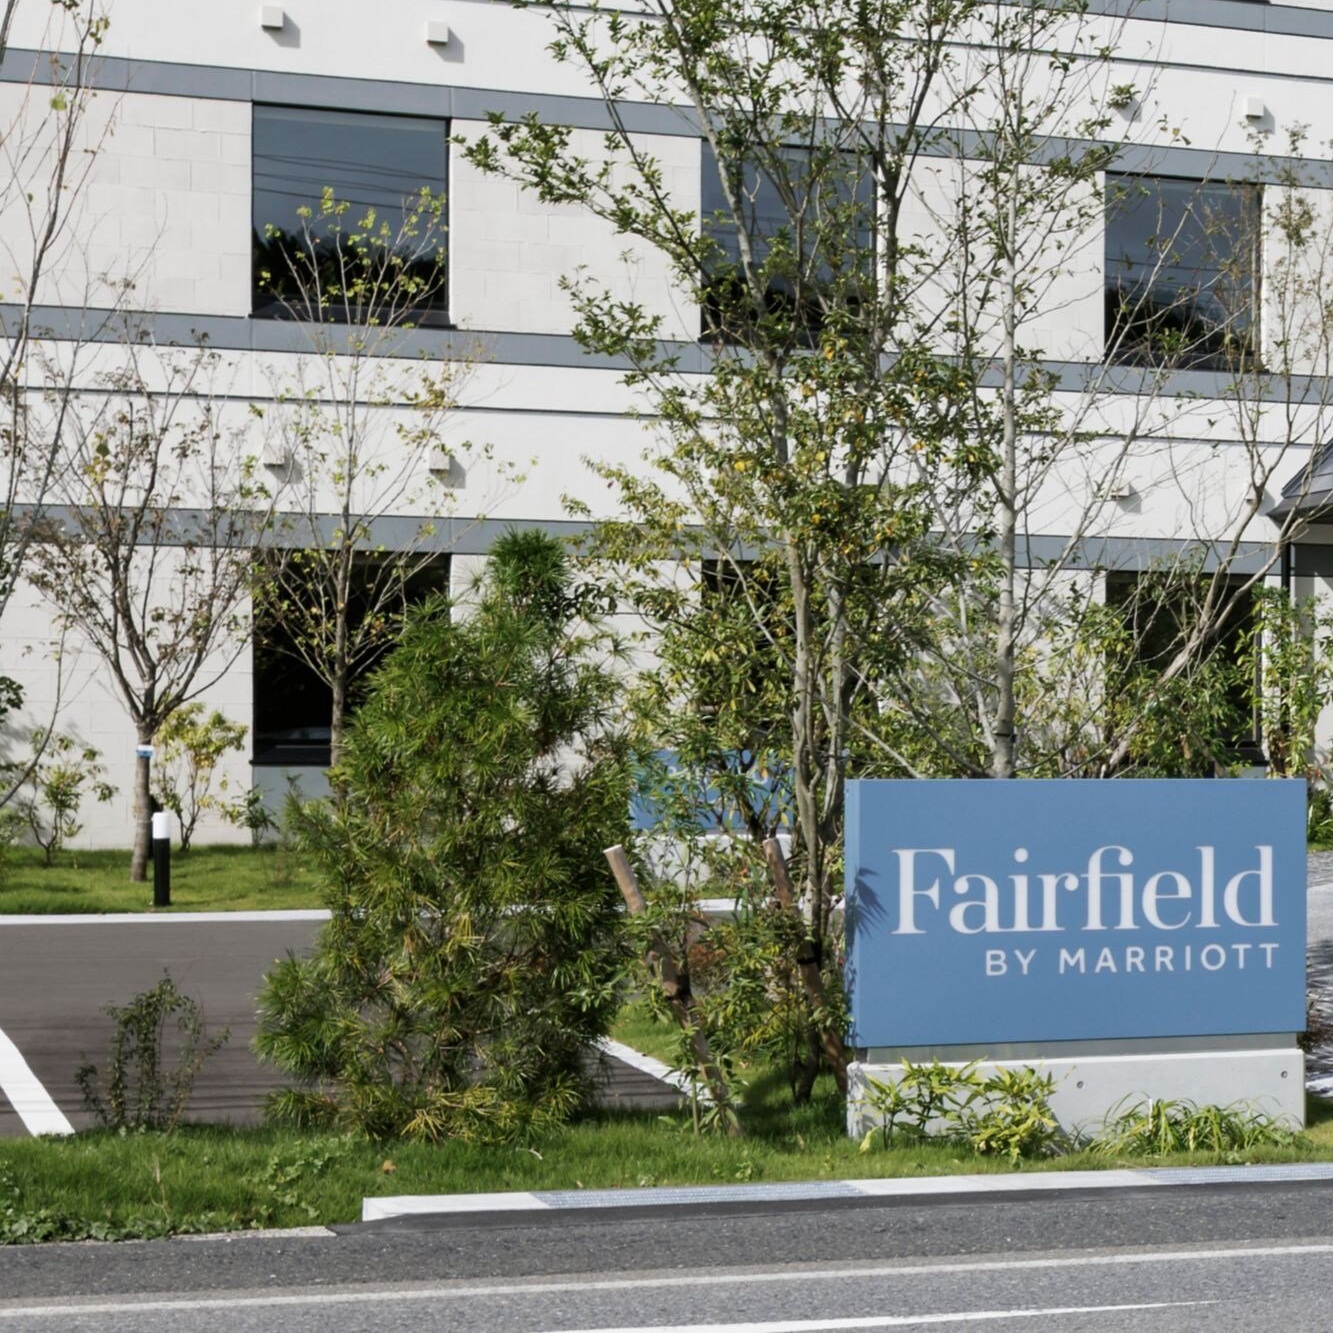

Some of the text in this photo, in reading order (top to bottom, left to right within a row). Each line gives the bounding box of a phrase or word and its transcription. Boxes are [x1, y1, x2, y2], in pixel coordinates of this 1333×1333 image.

[891, 845, 1279, 934] Fairfield
[986, 943, 1280, 976] BY MARRIOTT
